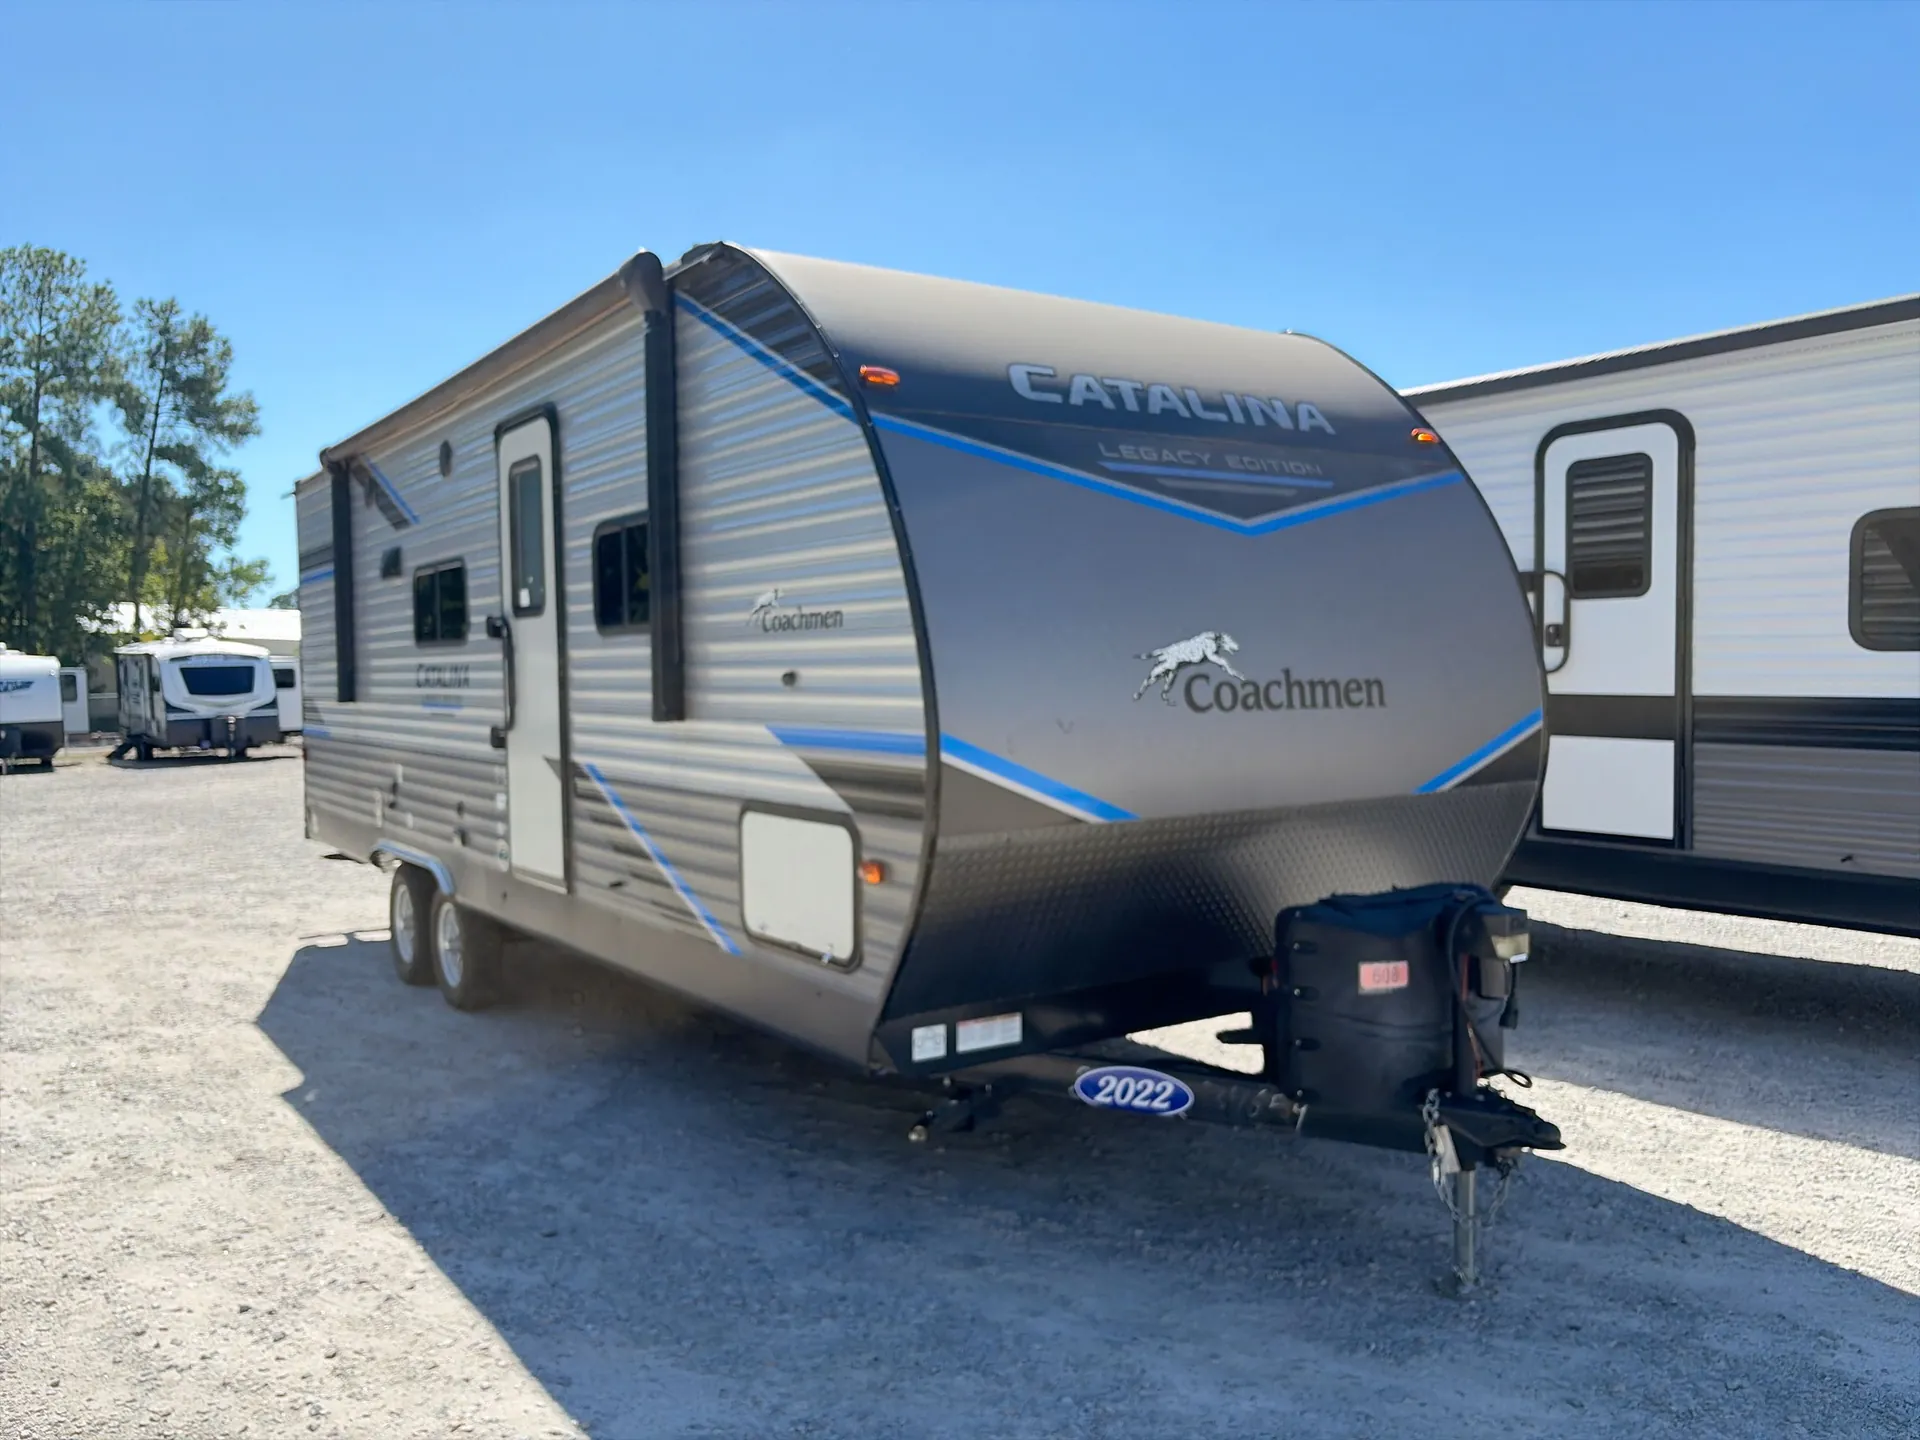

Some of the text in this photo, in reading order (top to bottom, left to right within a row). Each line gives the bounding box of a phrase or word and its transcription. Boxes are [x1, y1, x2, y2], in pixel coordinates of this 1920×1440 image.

[1007, 363, 1336, 435] CATALINA
[1097, 441, 1323, 476] LEGACY EDITION
[762, 604, 843, 633] Coachmen
[416, 663, 470, 689] CATALINA
[1183, 667, 1387, 713] Coachmen
[1094, 1075, 1175, 1110] 2022
